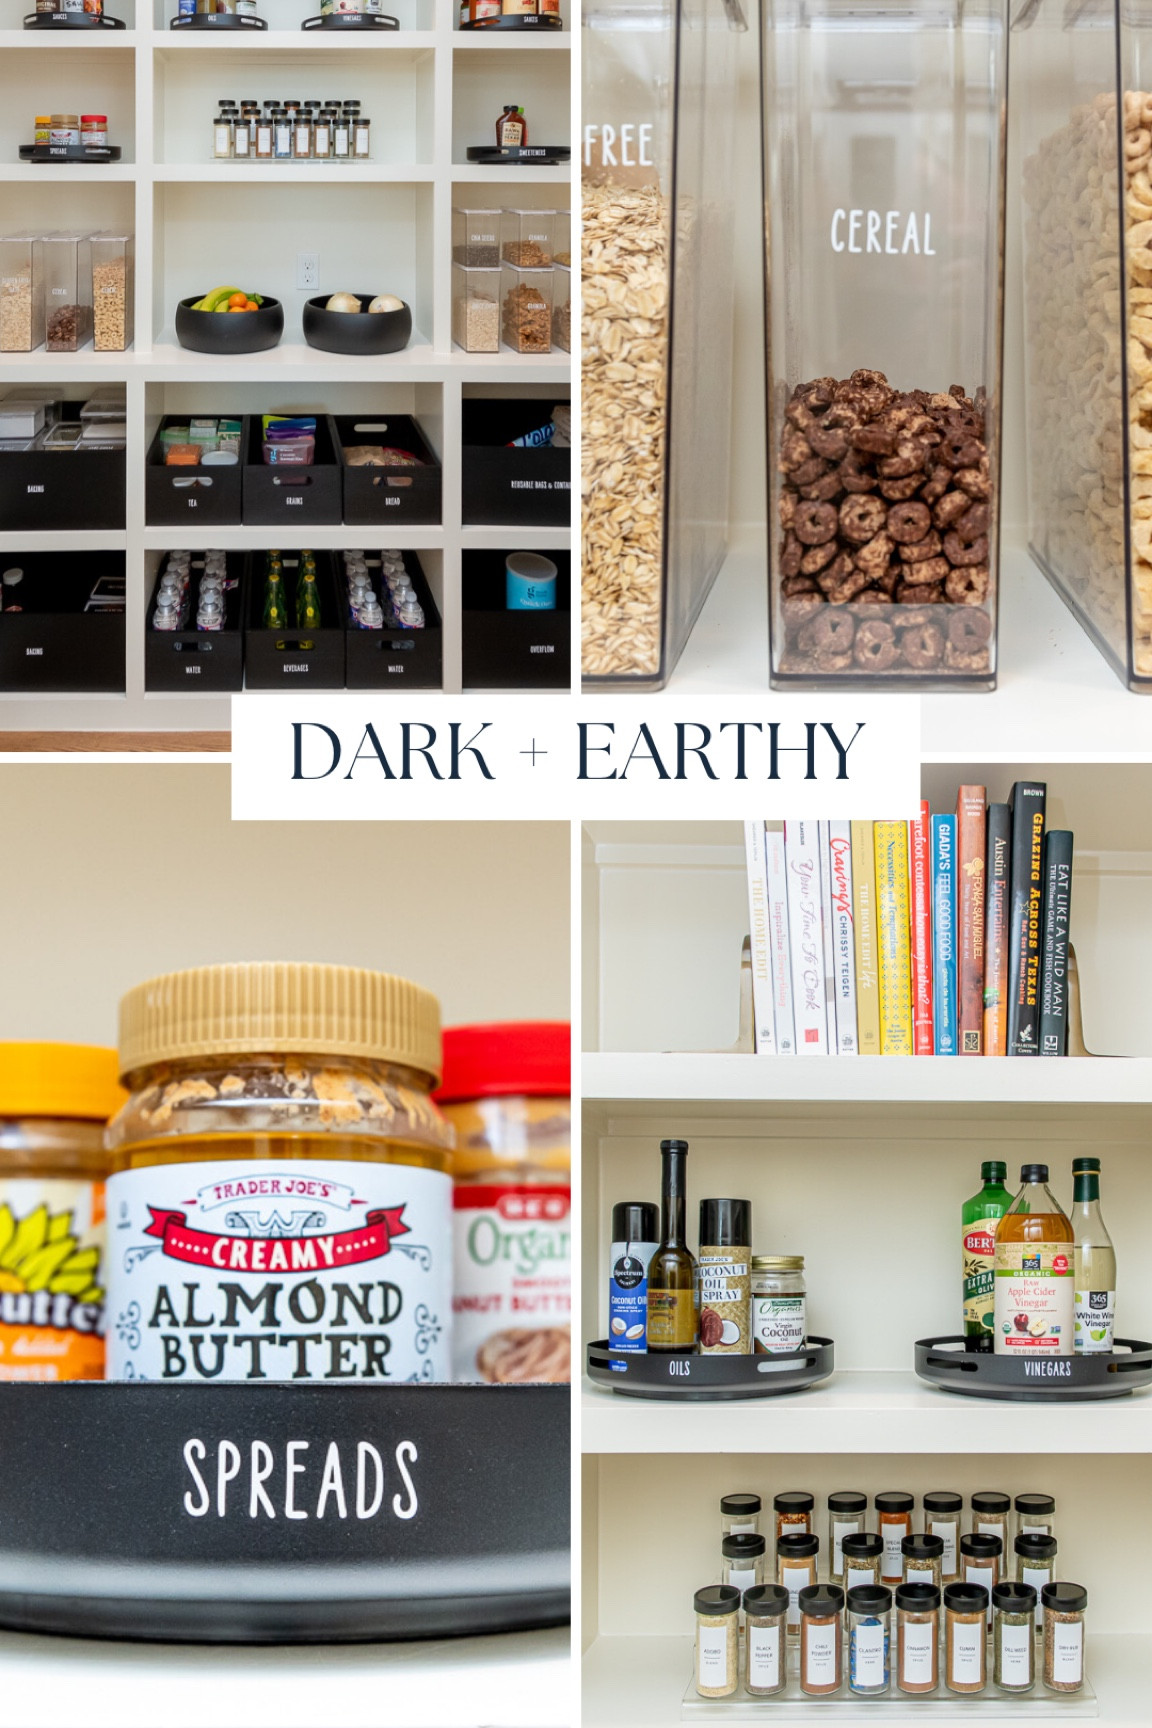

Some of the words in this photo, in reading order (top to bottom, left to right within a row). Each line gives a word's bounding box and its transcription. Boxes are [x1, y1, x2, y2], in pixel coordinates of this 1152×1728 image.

[584, 123, 653, 166] FREE
[830, 208, 936, 256] CEREAL
[1023, 789, 1044, 797] BROWN
[939, 824, 951, 871] GIADA'S
[994, 836, 1007, 876] Austin
[1030, 813, 1043, 880] GRAZING
[886, 841, 897, 889] Necessities
[1058, 864, 1069, 889] EAT
[830, 837, 853, 926] Cravings
[940, 873, 951, 895] FEEL
[940, 899, 951, 930] GOOD
[973, 907, 983, 925] SAN
[993, 879, 1006, 943] Entertains
[1029, 887, 1041, 948] ACROSS
[1047, 911, 1055, 932] GAME
[1056, 894, 1068, 922] LIKE
[839, 915, 849, 958] CHRISSY
[973, 926, 984, 960] MIGUEL
[1046, 934, 1054, 950] AND
[1055, 927, 1066, 937] A
[940, 932, 952, 961] FOOD
[1054, 942, 1065, 977] WILD
[841, 962, 850, 998] TEIGEN
[1027, 956, 1039, 1005] TEXAS
[1043, 972, 1053, 1015] COOKBOOK
[1052, 982, 1063, 1016] MAN
[213, 1179, 282, 1199] TRADER
[285, 1179, 331, 1198] JOE'S
[211, 1236, 336, 1270] CREAMY
[1024, 1259, 1039, 1268] 365
[704, 1279, 724, 1289] OIL
[967, 1272, 993, 1290] EXTRA
[1007, 1287, 1031, 1297] Apple
[1033, 1287, 1057, 1296] Cider
[148, 1278, 403, 1328] ALMOND
[511, 1293, 571, 1313] BUTT
[611, 1295, 637, 1305] Coconut
[703, 1290, 739, 1301] SPRAY
[1014, 1298, 1048, 1308] Vinegar
[1091, 1293, 1107, 1304] 365
[761, 1327, 802, 1337] Coconut
[1084, 1320, 1111, 1329] Vinegar
[161, 1332, 393, 1380] BUTTER
[669, 1360, 691, 1376] OILS
[1024, 1361, 1071, 1377] VINEGARS
[183, 1438, 419, 1520] SPREADS
